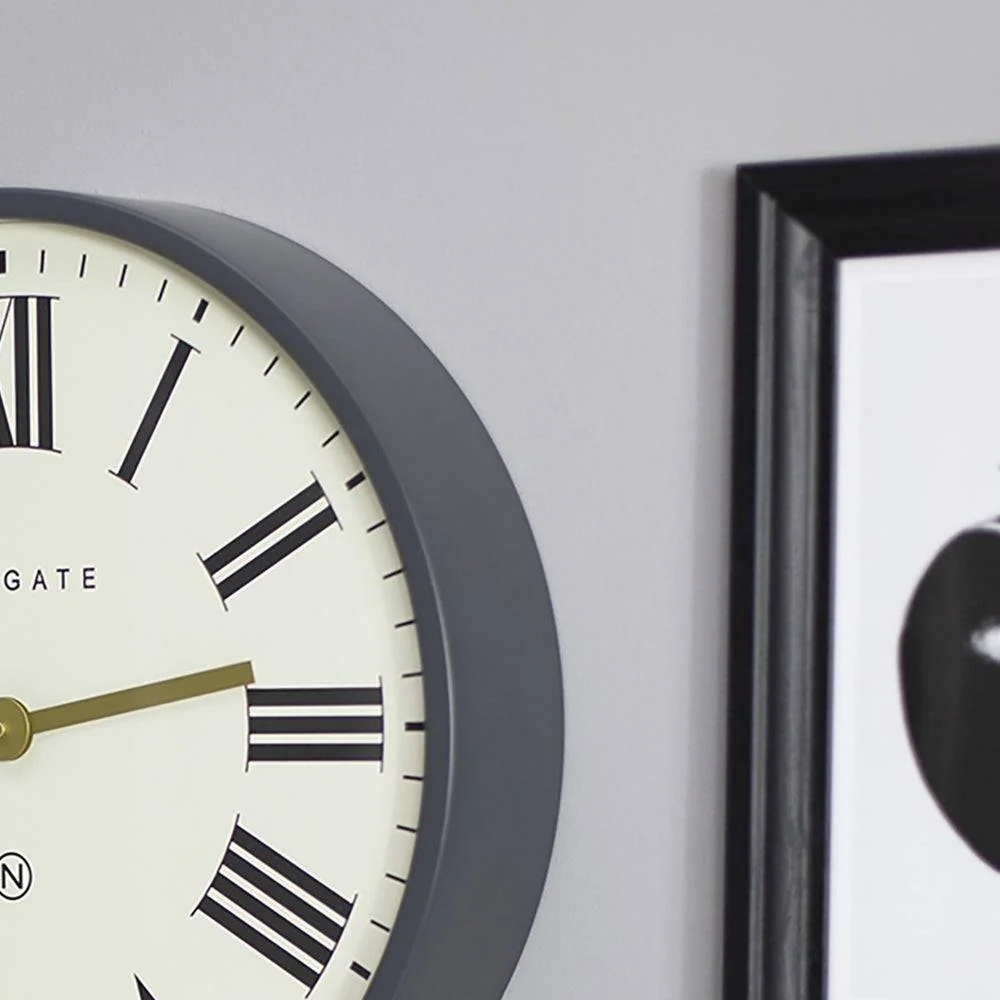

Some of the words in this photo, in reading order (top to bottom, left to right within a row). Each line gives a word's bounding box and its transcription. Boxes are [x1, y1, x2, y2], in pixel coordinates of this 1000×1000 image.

[108, 334, 200, 490] I
[197, 471, 343, 611] II
[246, 676, 385, 773] III
[1, 862, 23, 891] N
